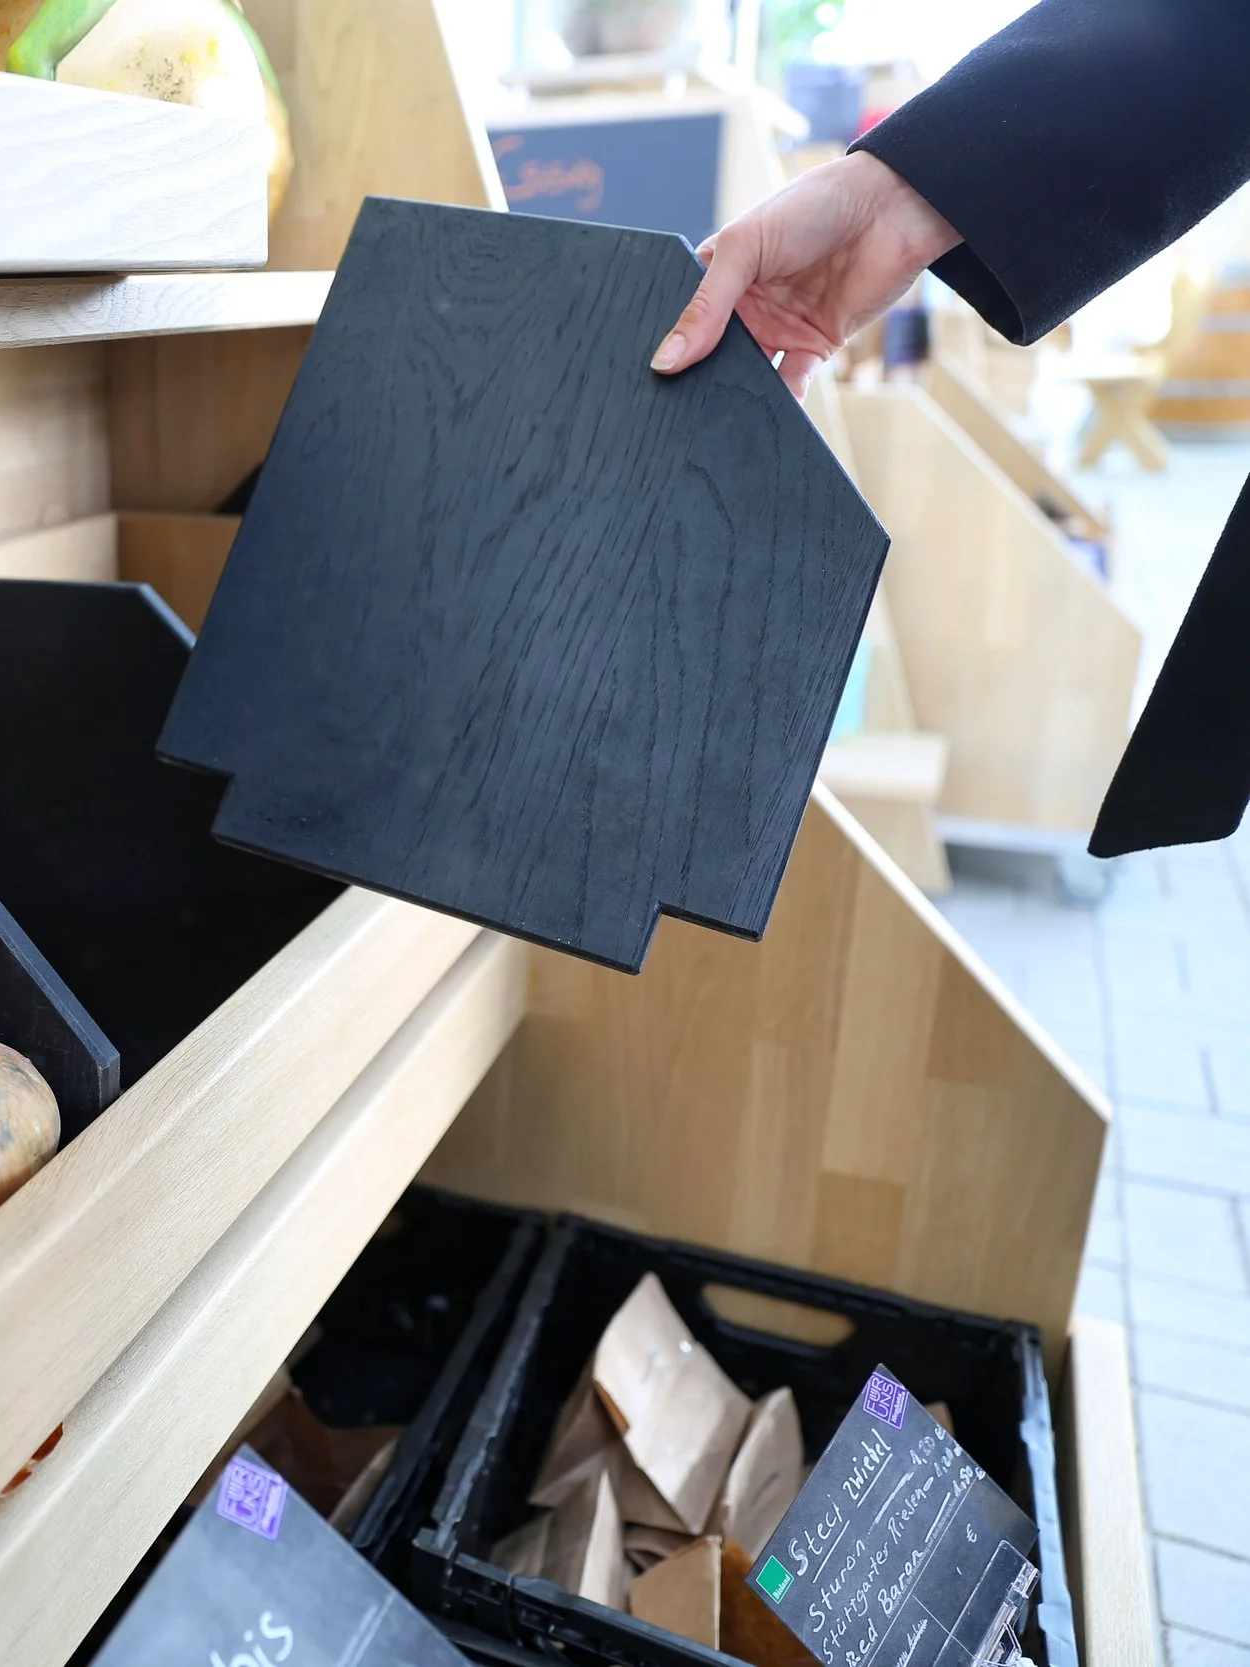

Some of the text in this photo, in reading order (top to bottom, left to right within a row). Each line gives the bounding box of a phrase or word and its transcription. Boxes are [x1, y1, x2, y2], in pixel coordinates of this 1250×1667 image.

[876, 1382, 892, 1416] UNS
[967, 1524, 977, 1542] €
[809, 1540, 865, 1632] Sturon
[877, 1549, 924, 1616] Baron
